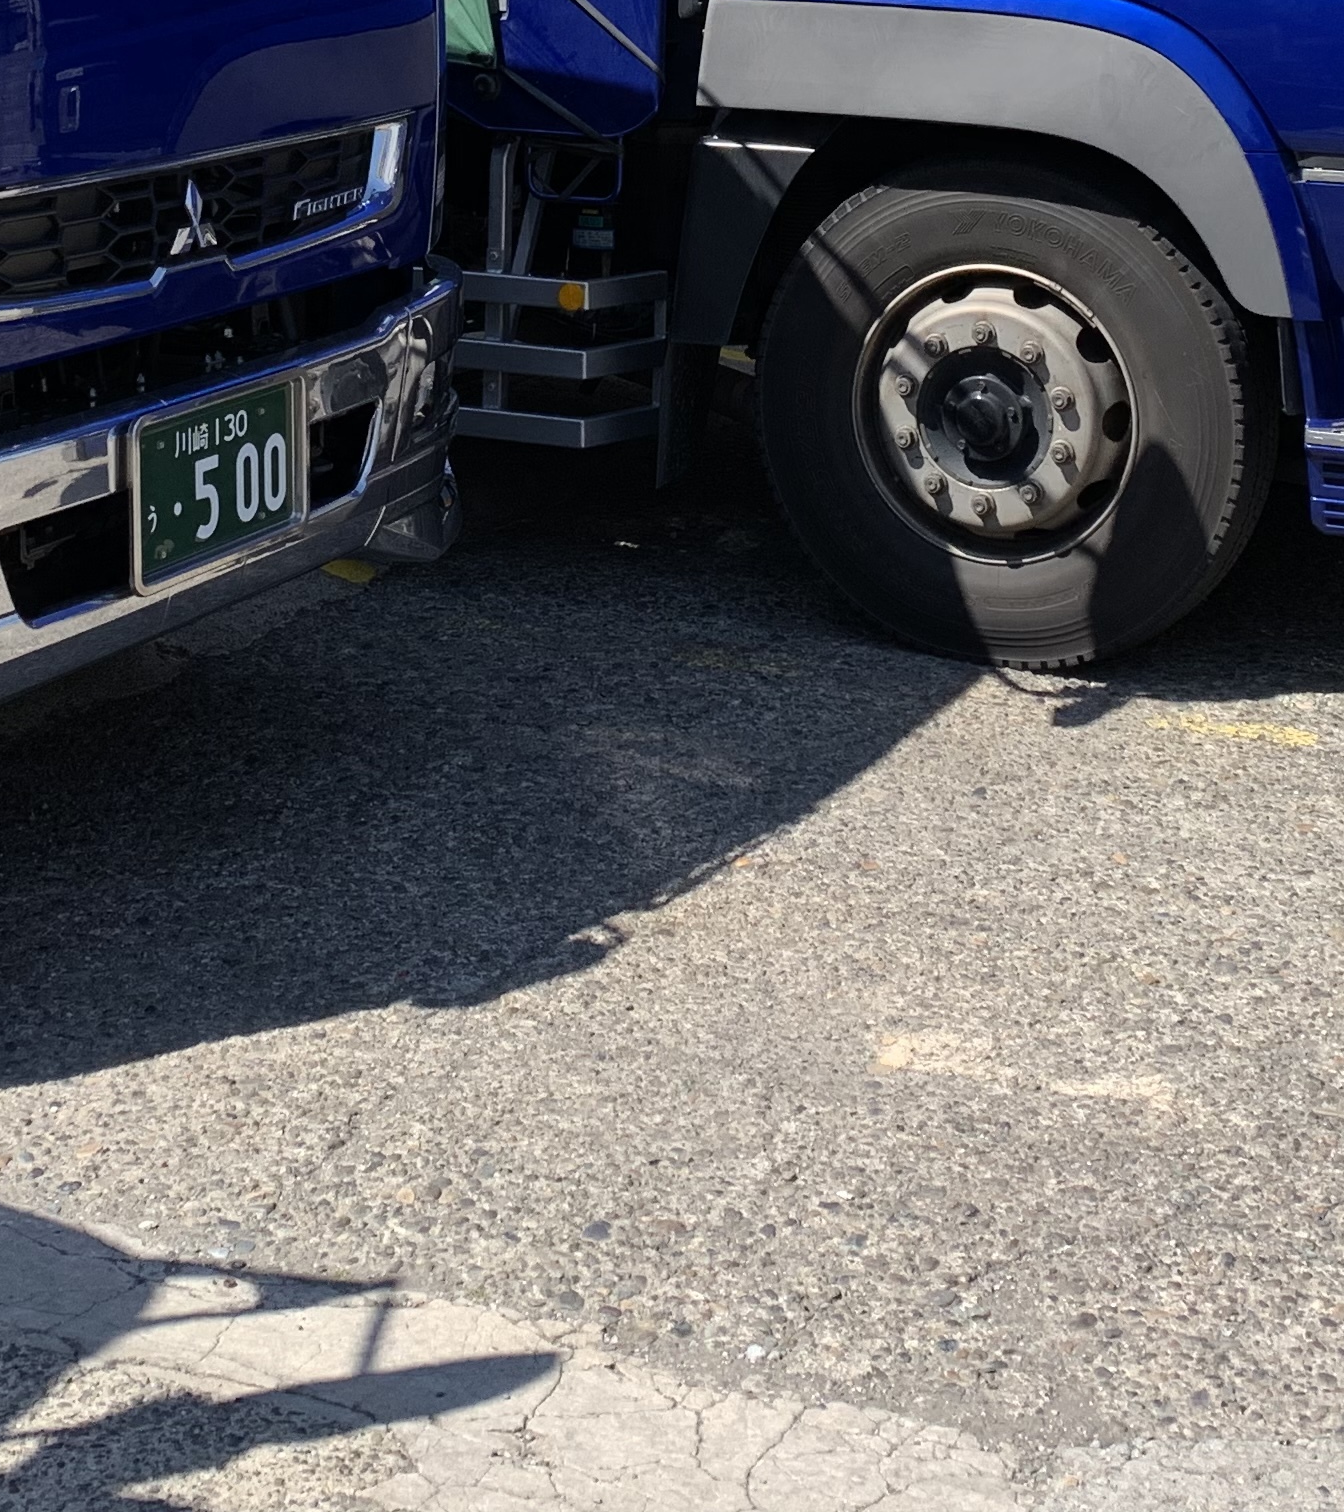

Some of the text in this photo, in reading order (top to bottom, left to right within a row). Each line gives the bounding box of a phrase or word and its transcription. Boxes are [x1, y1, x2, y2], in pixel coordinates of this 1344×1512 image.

[993, 211, 1137, 305] YOKOHAMA
[175, 408, 248, 458] 川崎 130
